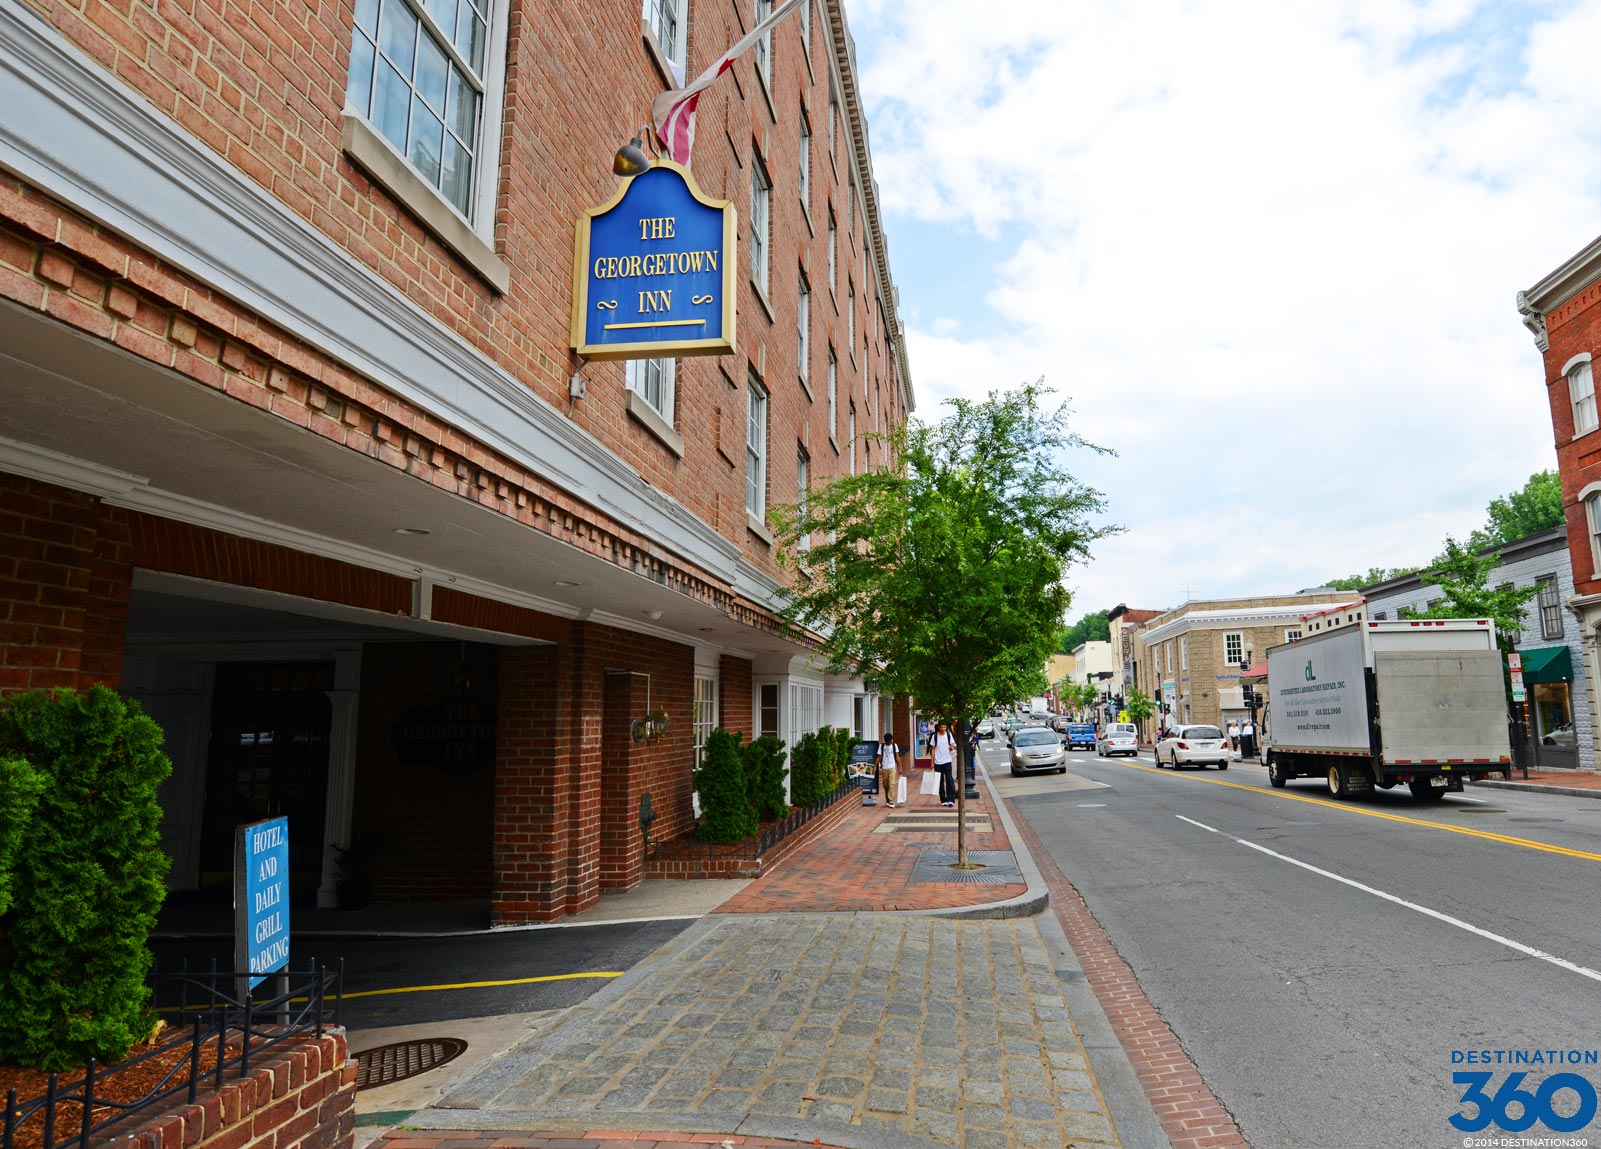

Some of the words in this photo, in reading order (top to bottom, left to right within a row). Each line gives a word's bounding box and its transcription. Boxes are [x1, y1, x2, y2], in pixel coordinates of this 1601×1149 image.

[639, 217, 676, 240] THE
[594, 250, 719, 279] GEORGETOWN
[637, 290, 673, 313] INN
[253, 826, 283, 854] HOTEL
[258, 856, 277, 882] AND
[255, 882, 282, 914] DAILY
[255, 911, 283, 944] GRILL
[250, 936, 290, 979] PARKING
